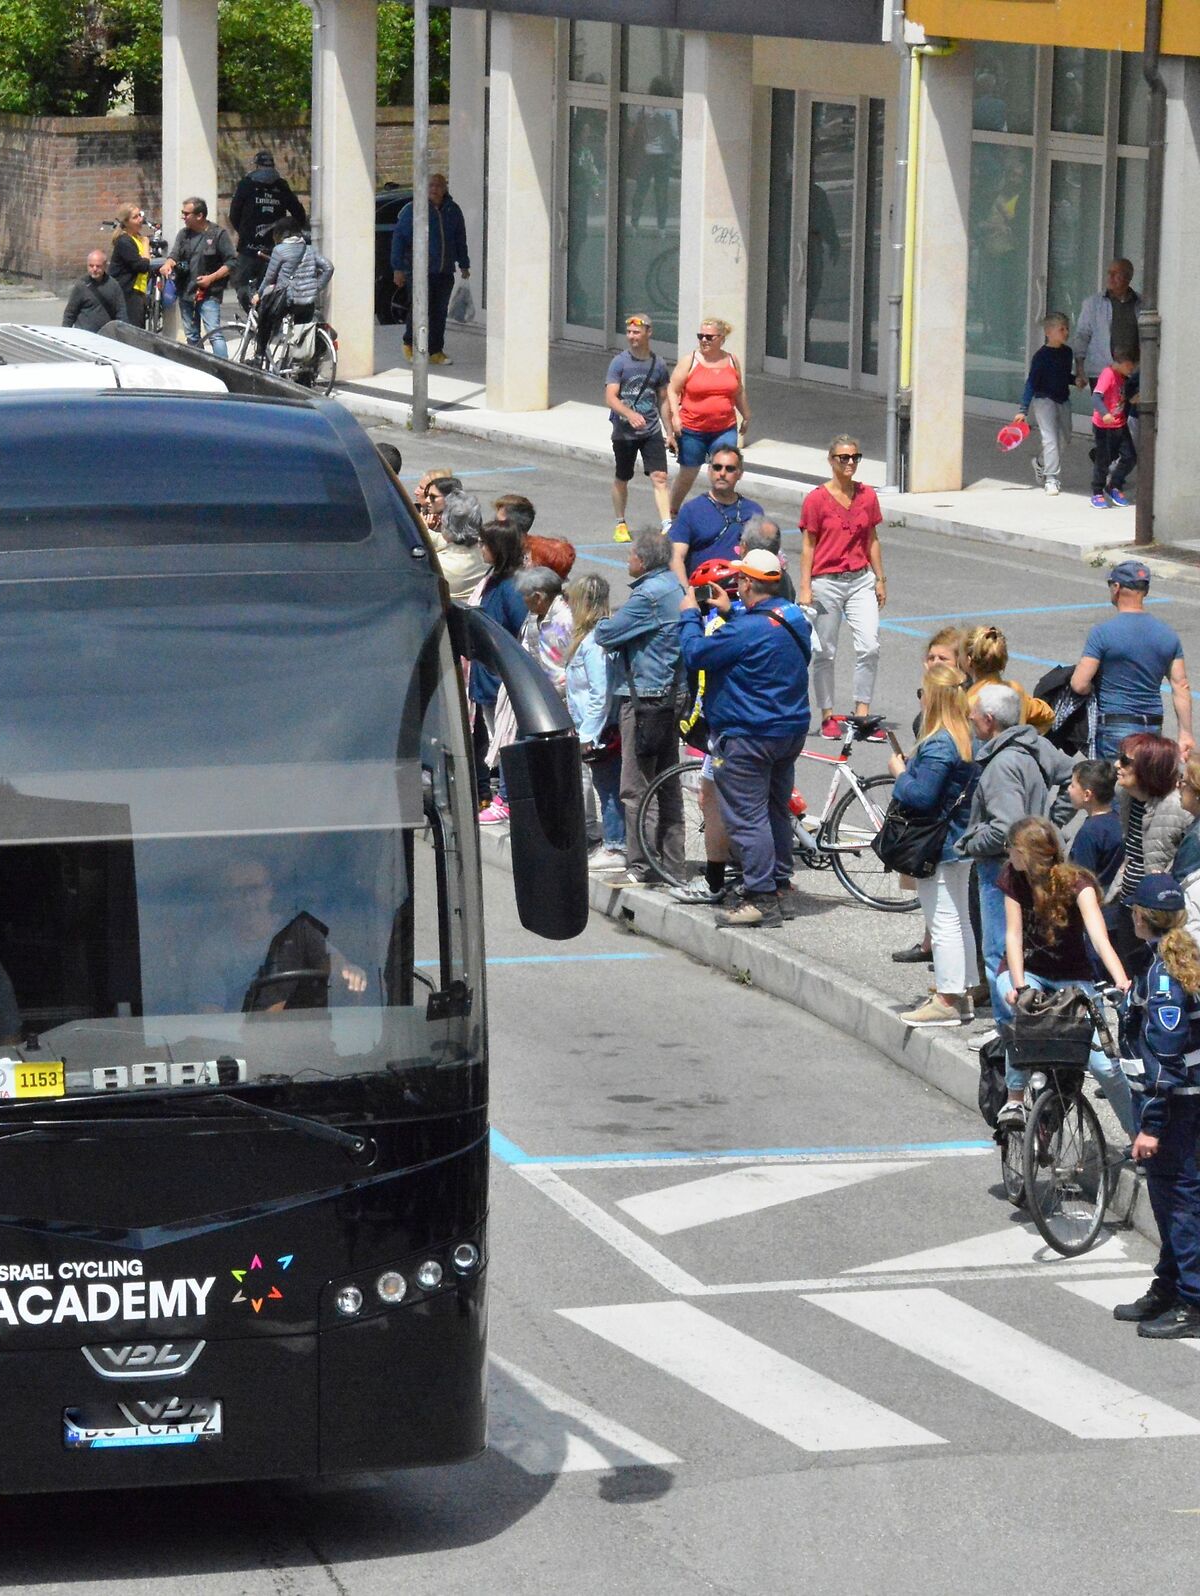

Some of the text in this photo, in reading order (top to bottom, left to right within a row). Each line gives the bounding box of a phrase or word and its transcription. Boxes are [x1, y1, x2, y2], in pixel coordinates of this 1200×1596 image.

[20, 1072, 58, 1088] 1153
[58, 1259, 143, 1279] CYCLING
[102, 1344, 182, 1366] VDL
